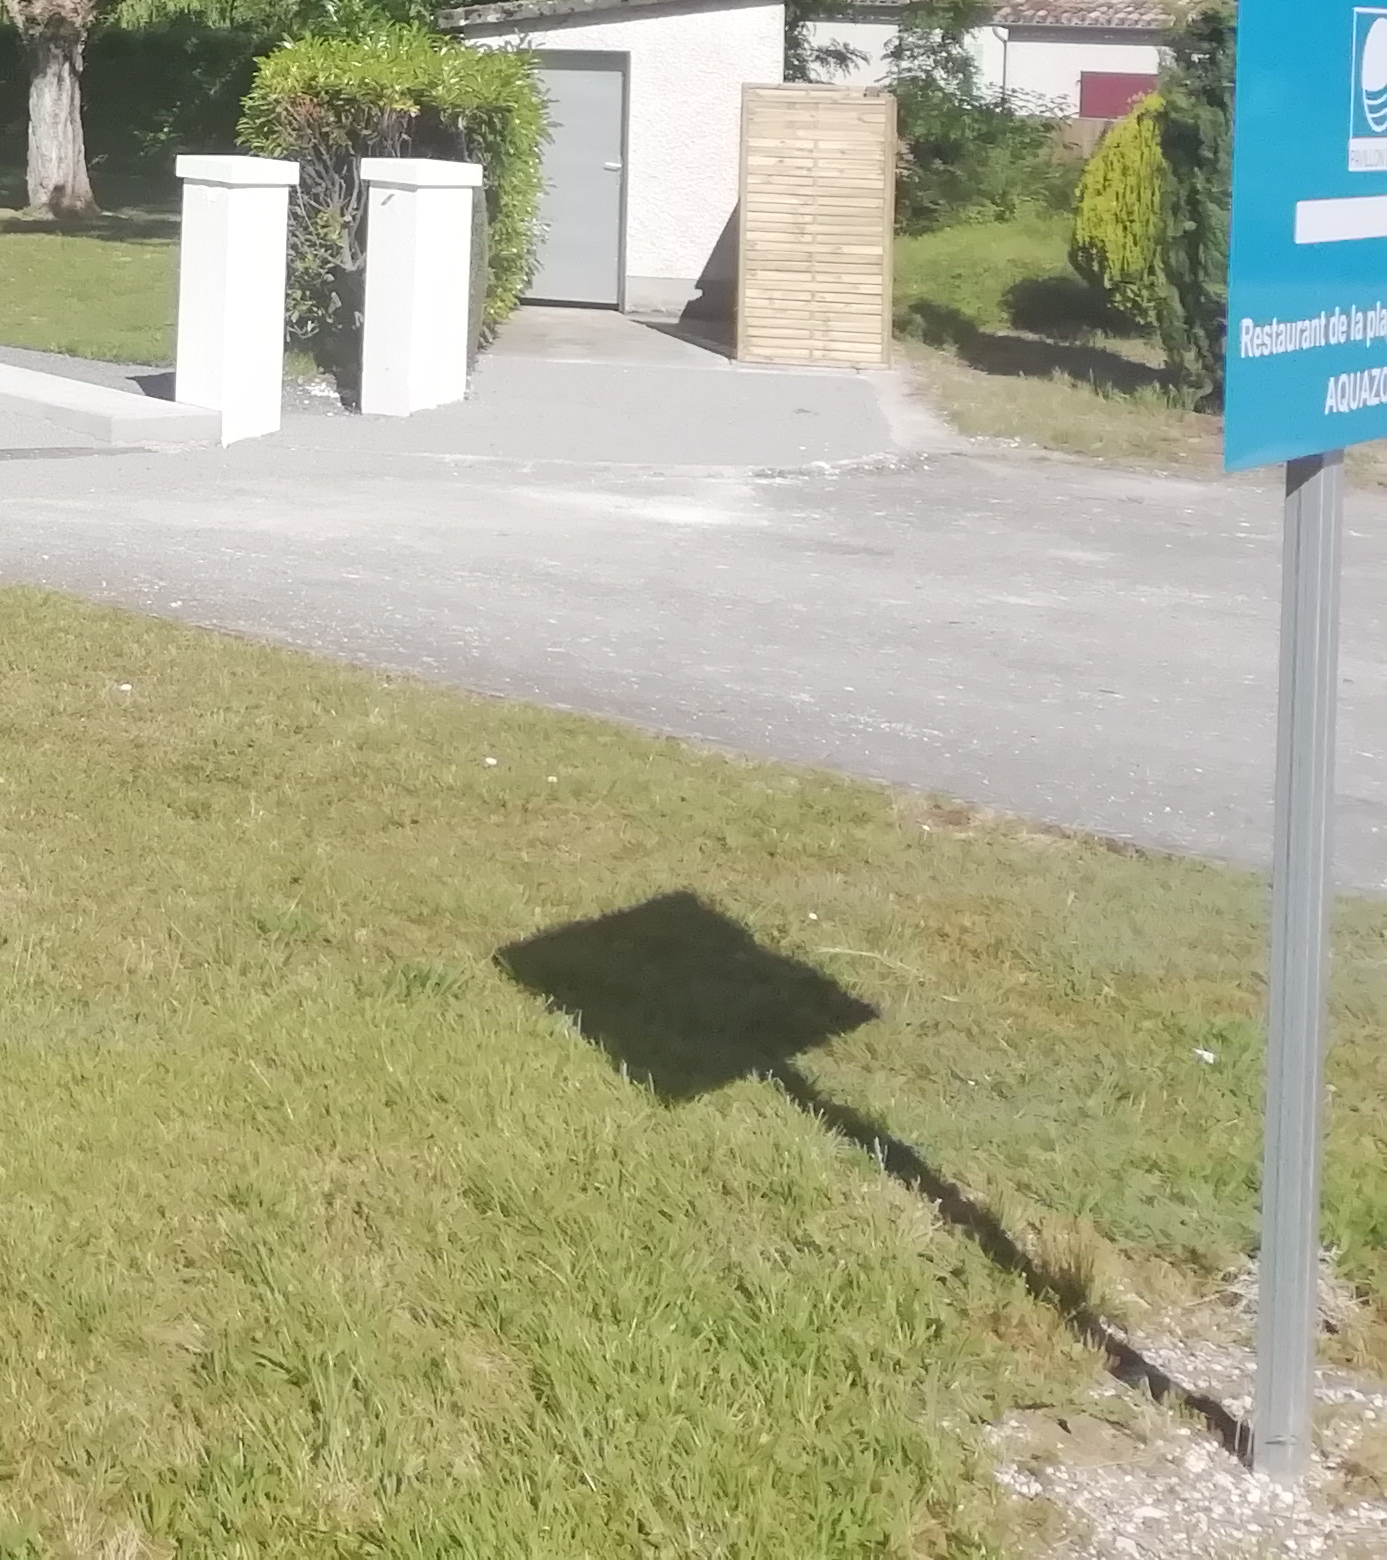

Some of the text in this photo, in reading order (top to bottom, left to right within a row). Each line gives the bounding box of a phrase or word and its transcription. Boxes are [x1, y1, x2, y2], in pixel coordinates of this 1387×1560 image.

[1240, 311, 1326, 358] Restaurant
[1329, 306, 1347, 345] de
[1350, 303, 1364, 341] la
